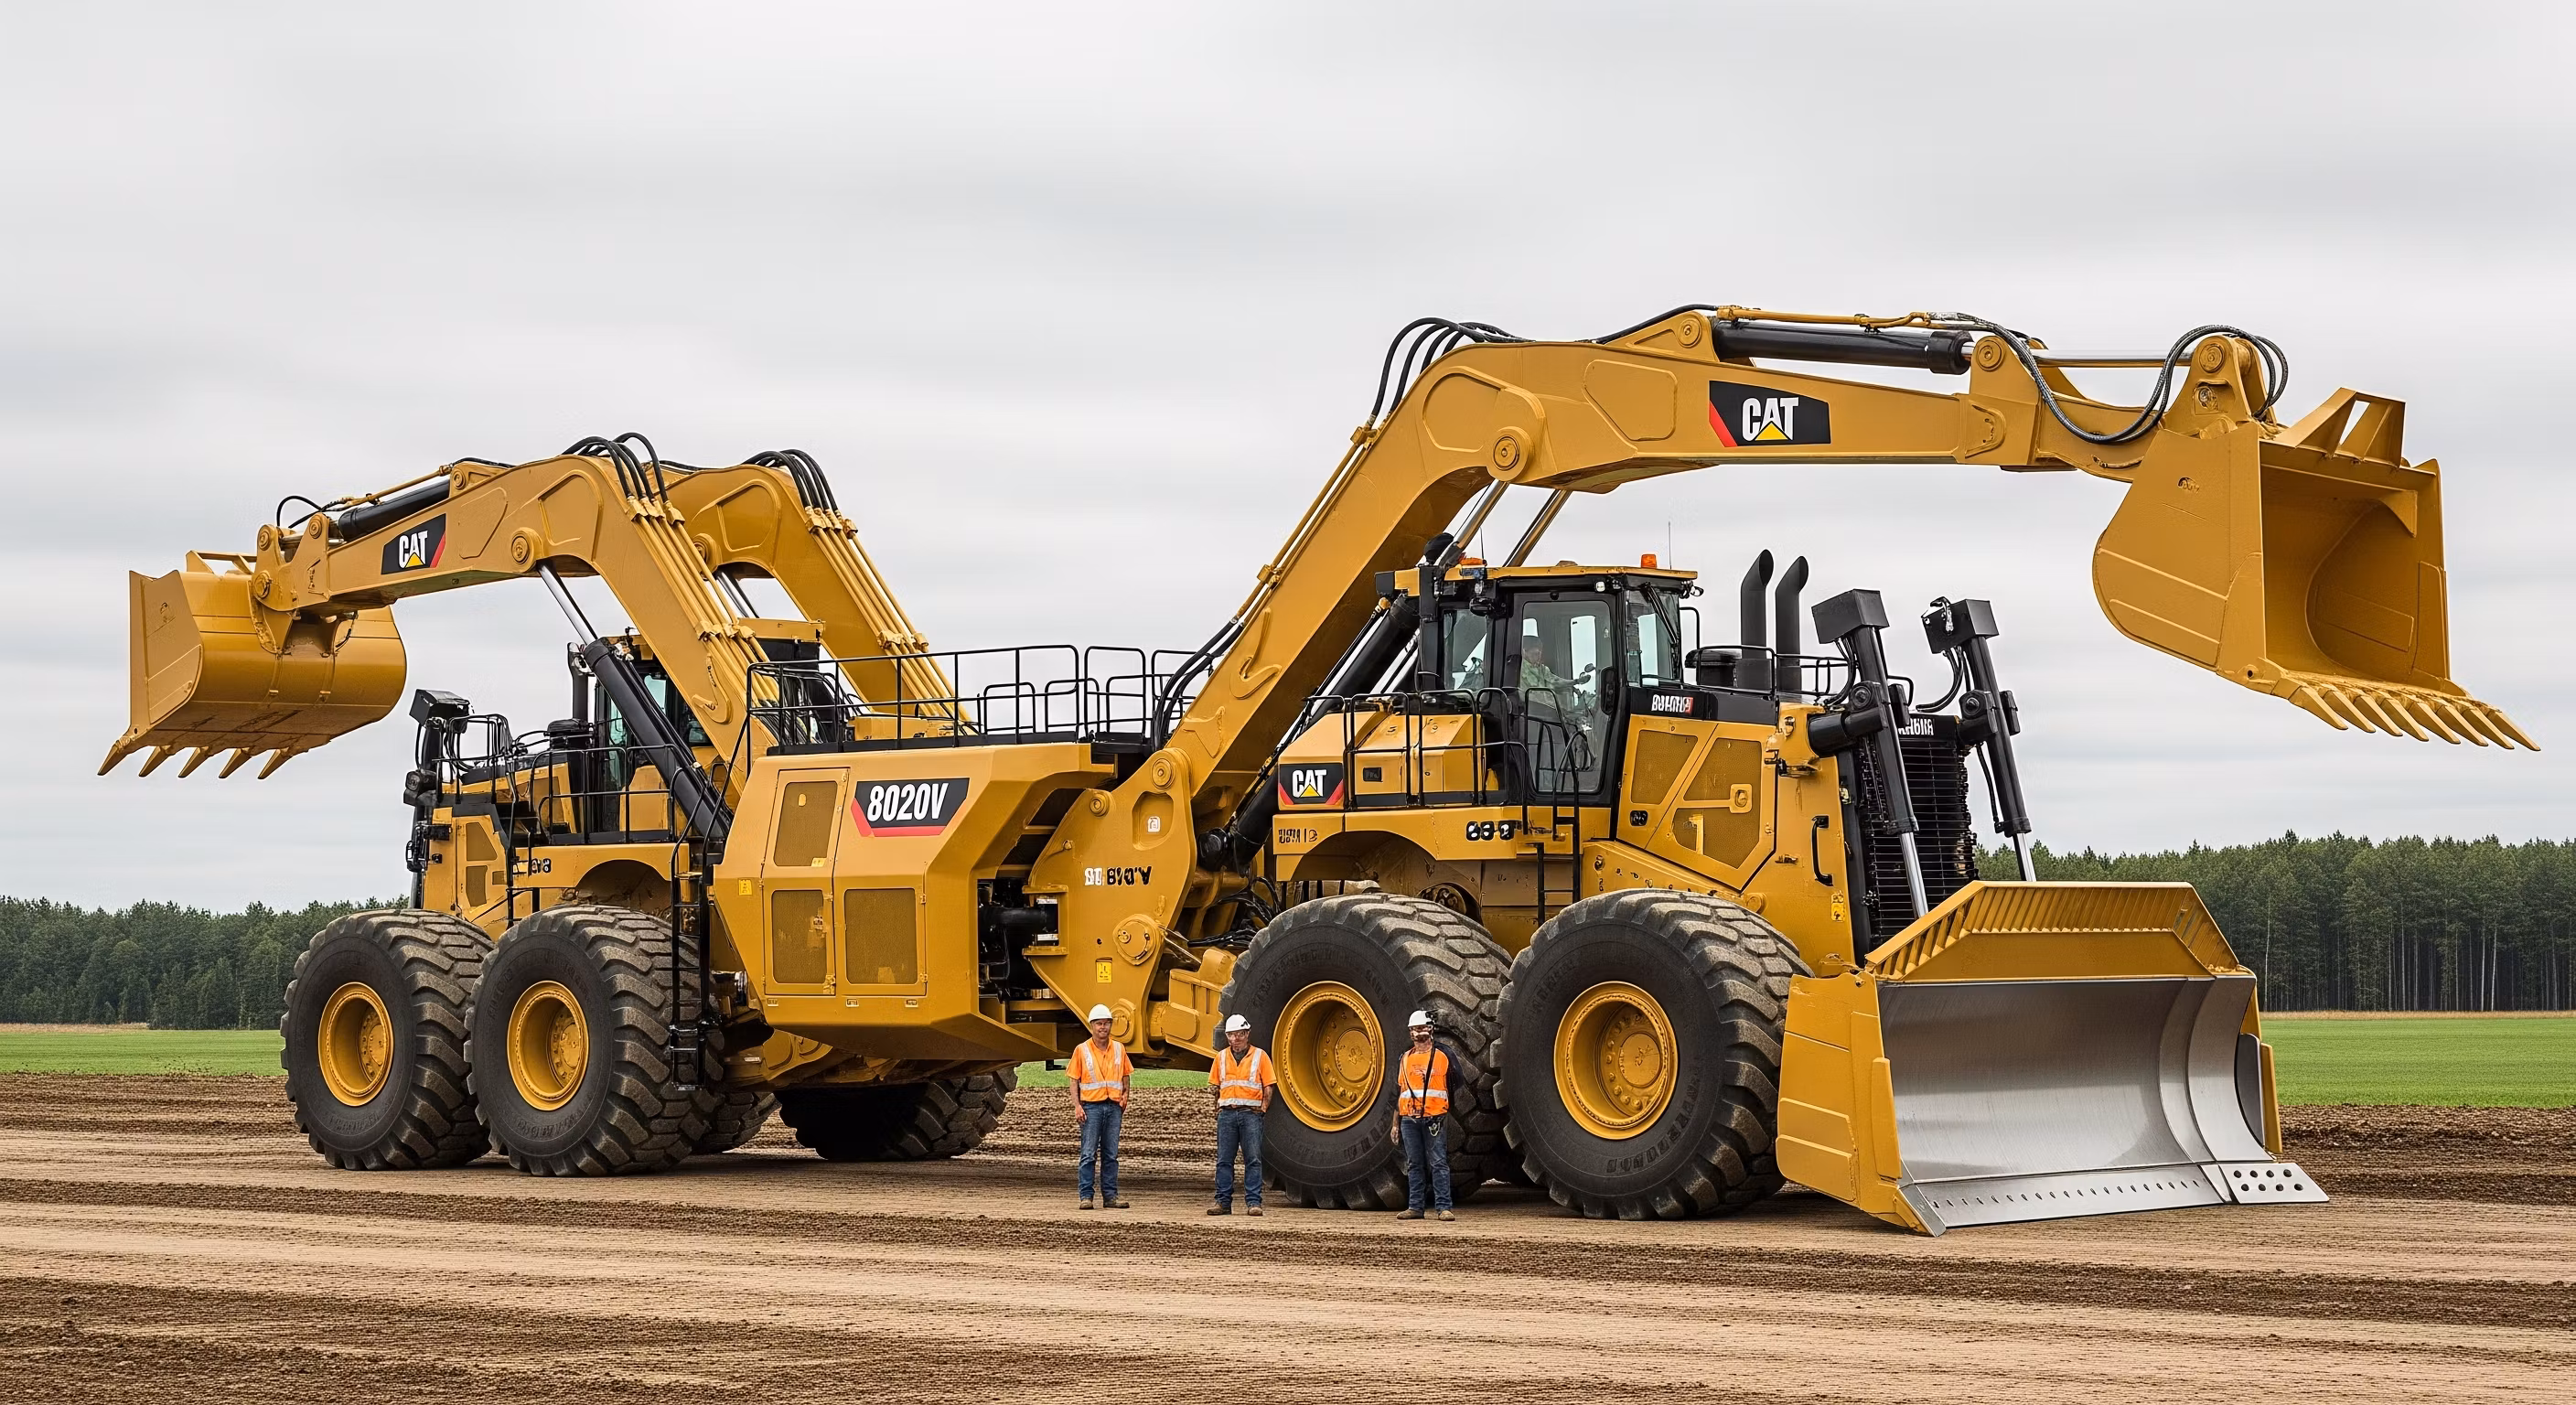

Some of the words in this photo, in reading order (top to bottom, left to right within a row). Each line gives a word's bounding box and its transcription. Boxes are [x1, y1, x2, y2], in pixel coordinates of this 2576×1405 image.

[1742, 396, 1799, 442] CAT
[398, 530, 428, 569] CAT
[866, 782, 950, 821] 8020V
[1292, 768, 1327, 798] CAT
